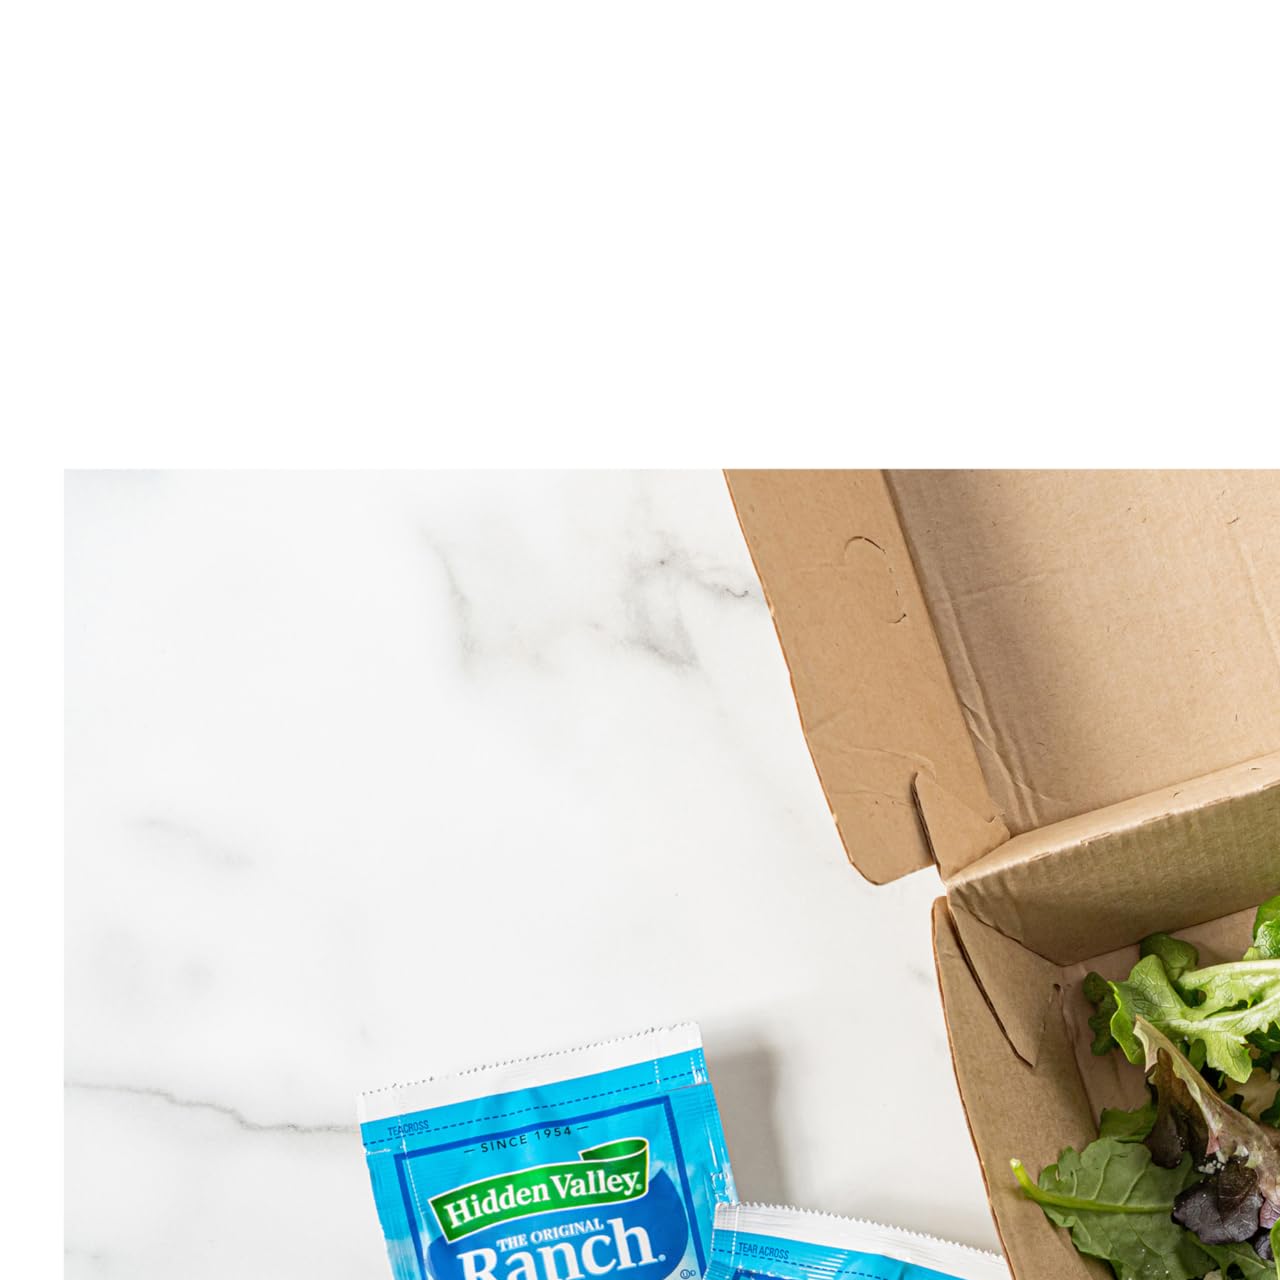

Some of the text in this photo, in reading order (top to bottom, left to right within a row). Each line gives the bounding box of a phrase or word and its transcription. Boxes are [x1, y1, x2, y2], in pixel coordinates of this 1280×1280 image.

[480, 1125, 572, 1153] SINCE 1954
[444, 1183, 550, 1229] Hidden
[496, 1217, 605, 1252] THE ORIGINAL
[738, 1241, 790, 1260] TEAR ACROSS
